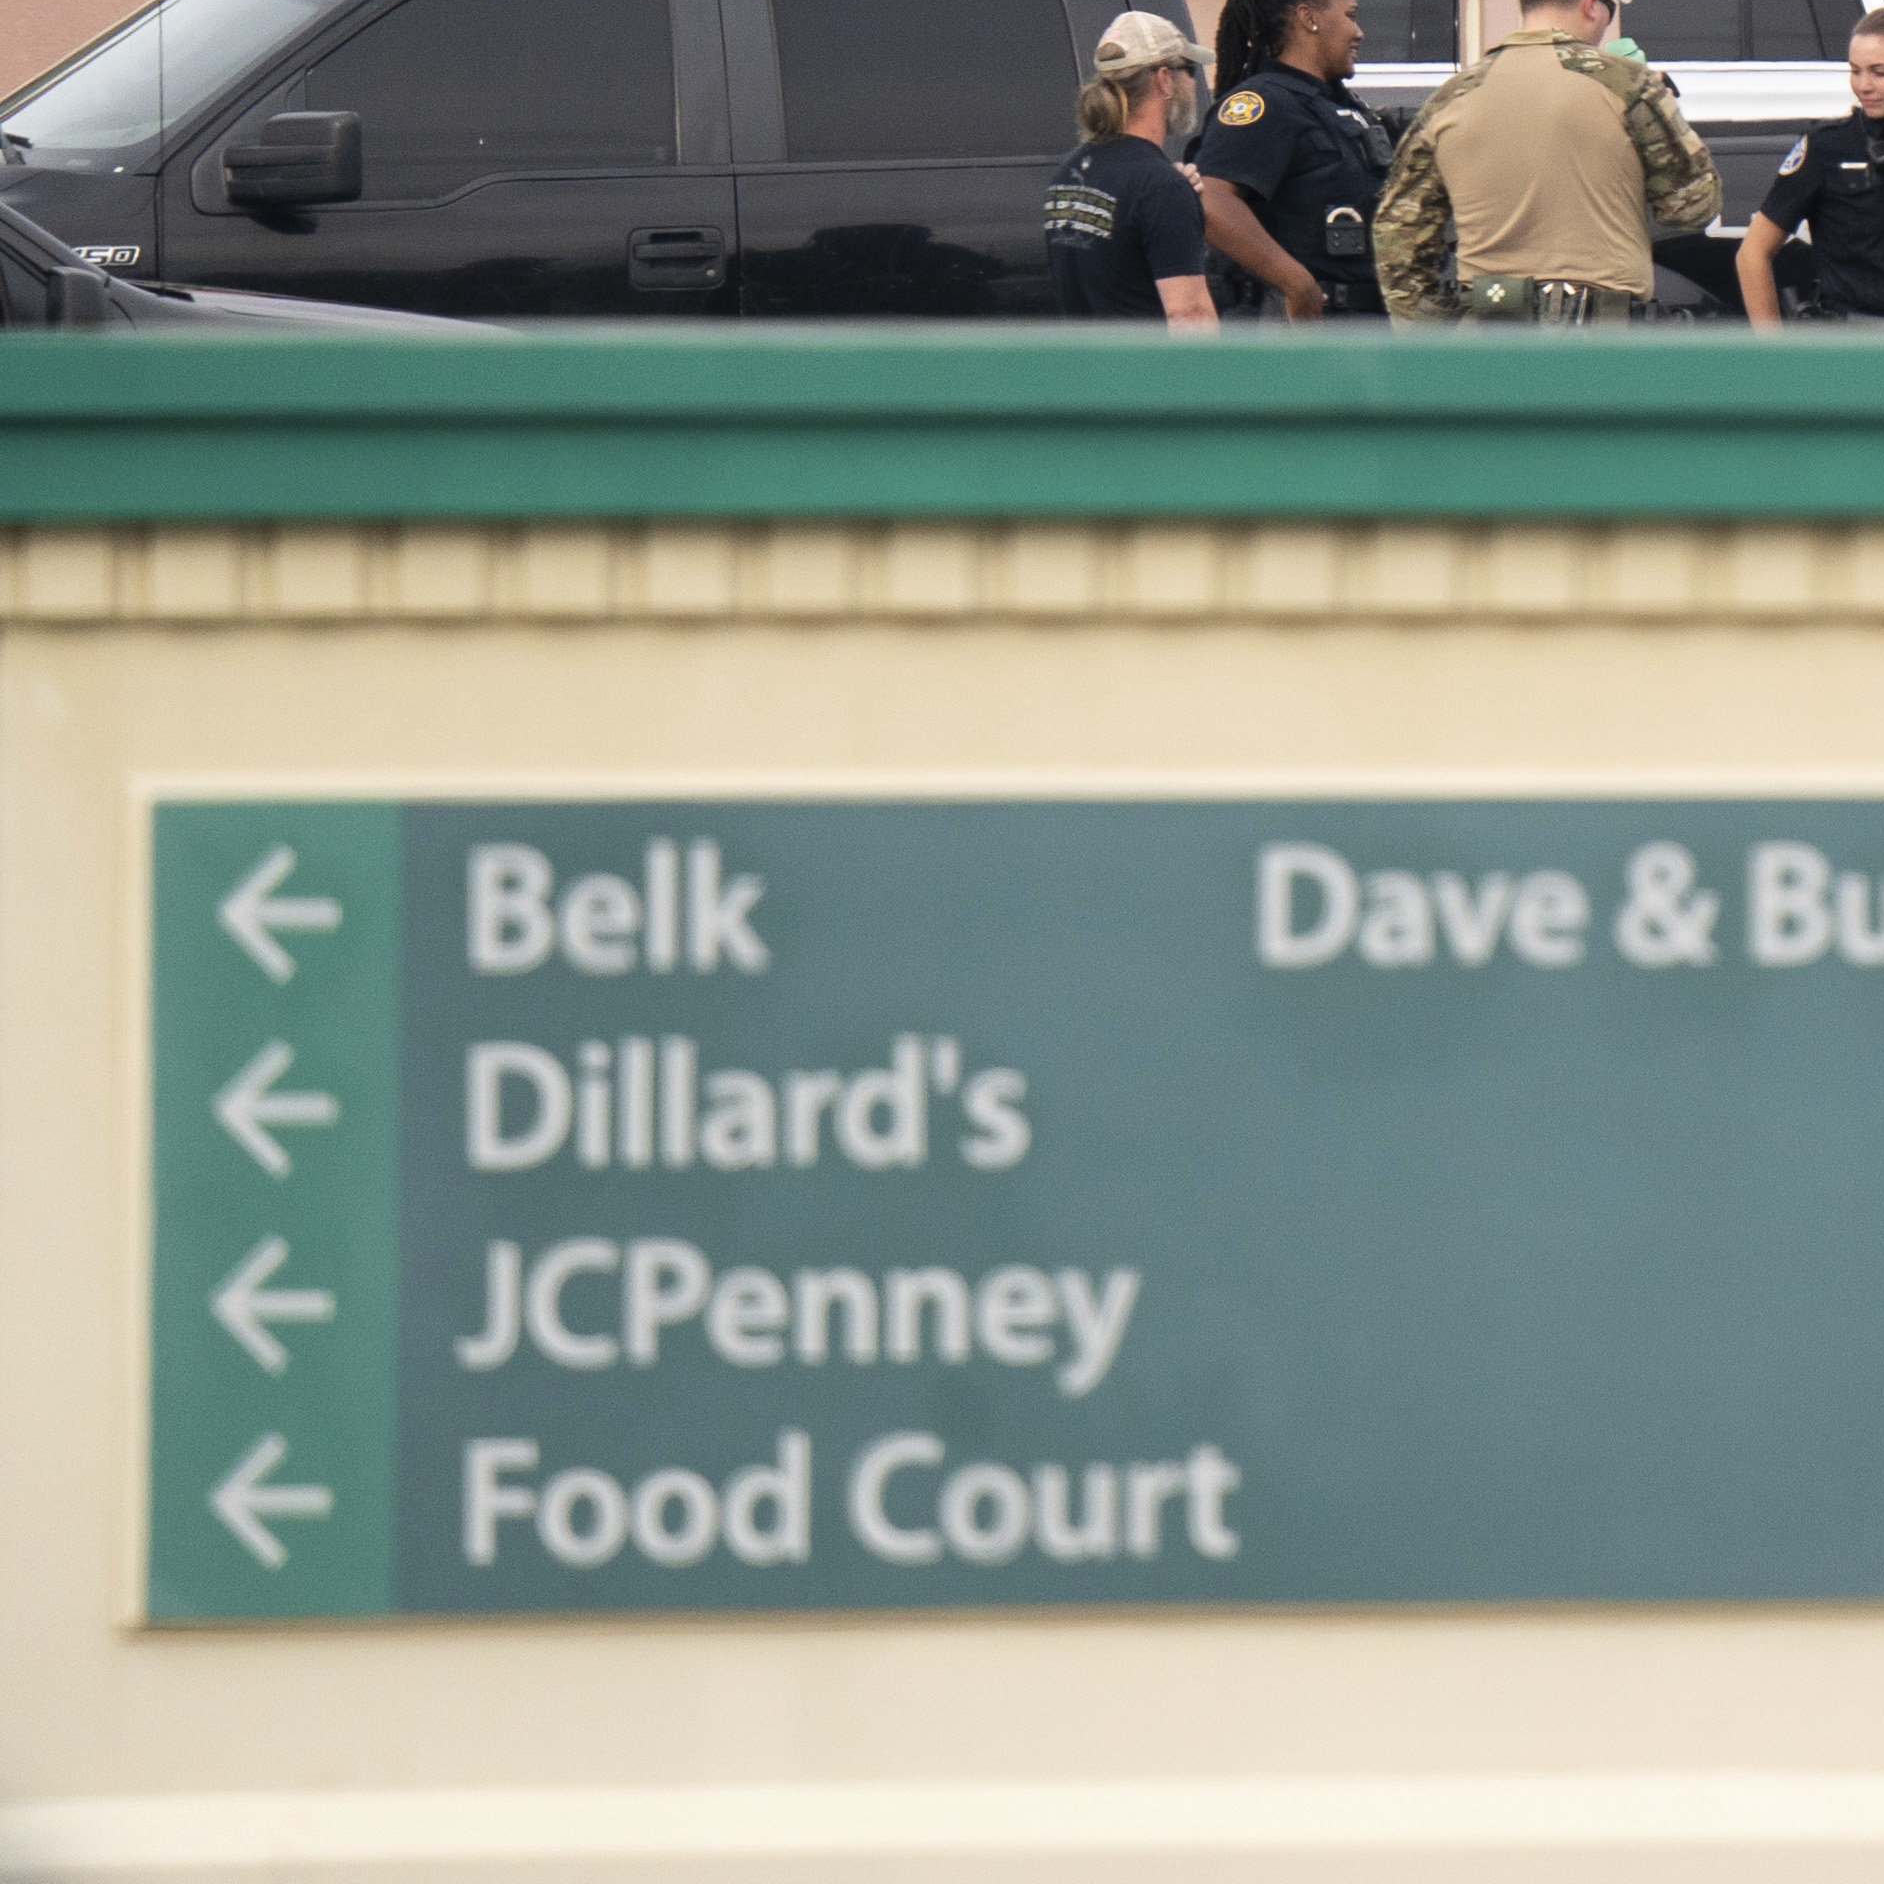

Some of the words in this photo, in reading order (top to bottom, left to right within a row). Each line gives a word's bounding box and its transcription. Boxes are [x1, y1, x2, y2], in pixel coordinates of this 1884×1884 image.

[466, 837, 769, 974] Belk
[1255, 841, 1592, 968] Dave
[1613, 840, 1720, 967] &
[464, 1034, 1031, 1170] Dillard's
[455, 1236, 1141, 1399] JCPenney
[461, 1429, 812, 1566] Food
[848, 1430, 1241, 1564] Court
